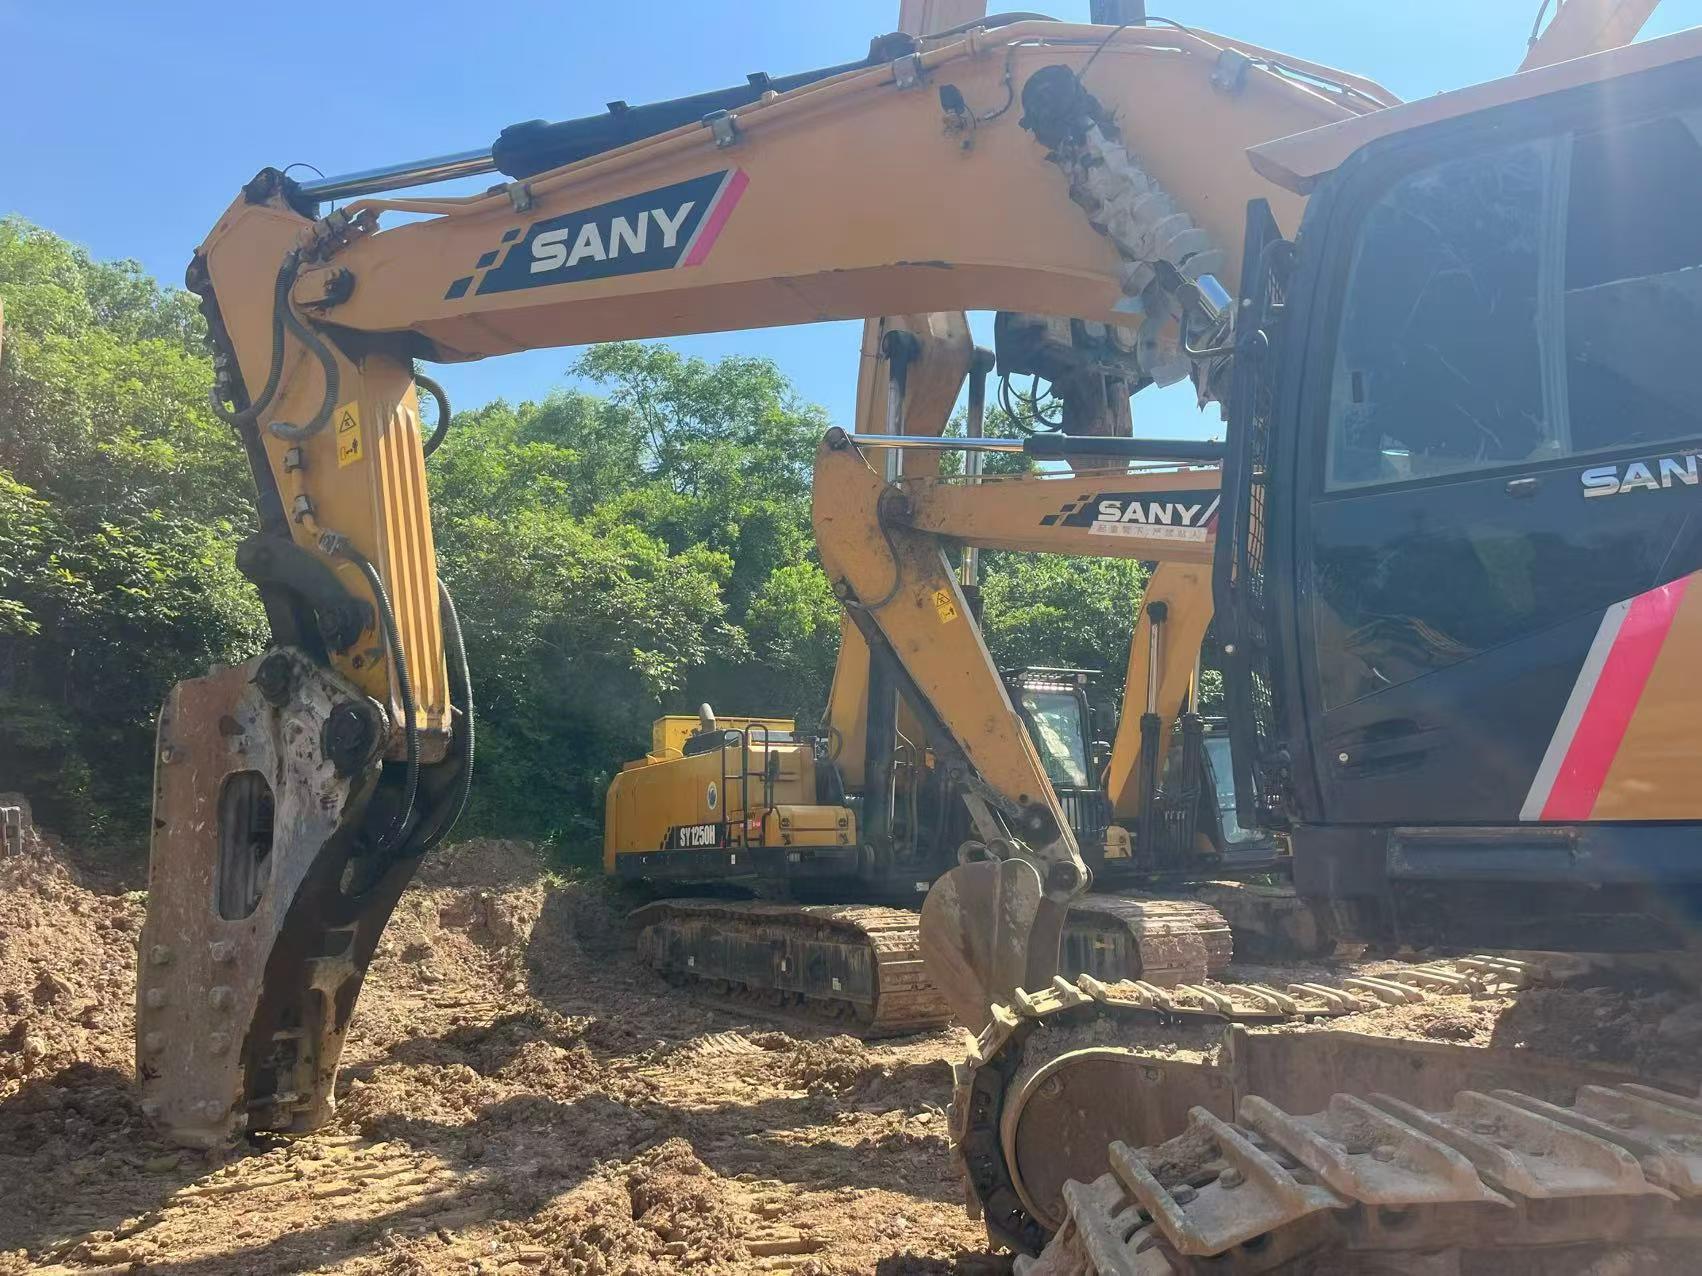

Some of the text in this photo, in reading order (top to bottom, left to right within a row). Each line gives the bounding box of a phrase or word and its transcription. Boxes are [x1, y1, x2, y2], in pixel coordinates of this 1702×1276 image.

[530, 201, 696, 274] SANY
[1581, 454, 1702, 498] SAN
[1097, 500, 1202, 526] SANY
[680, 825, 716, 847] SY1250H
